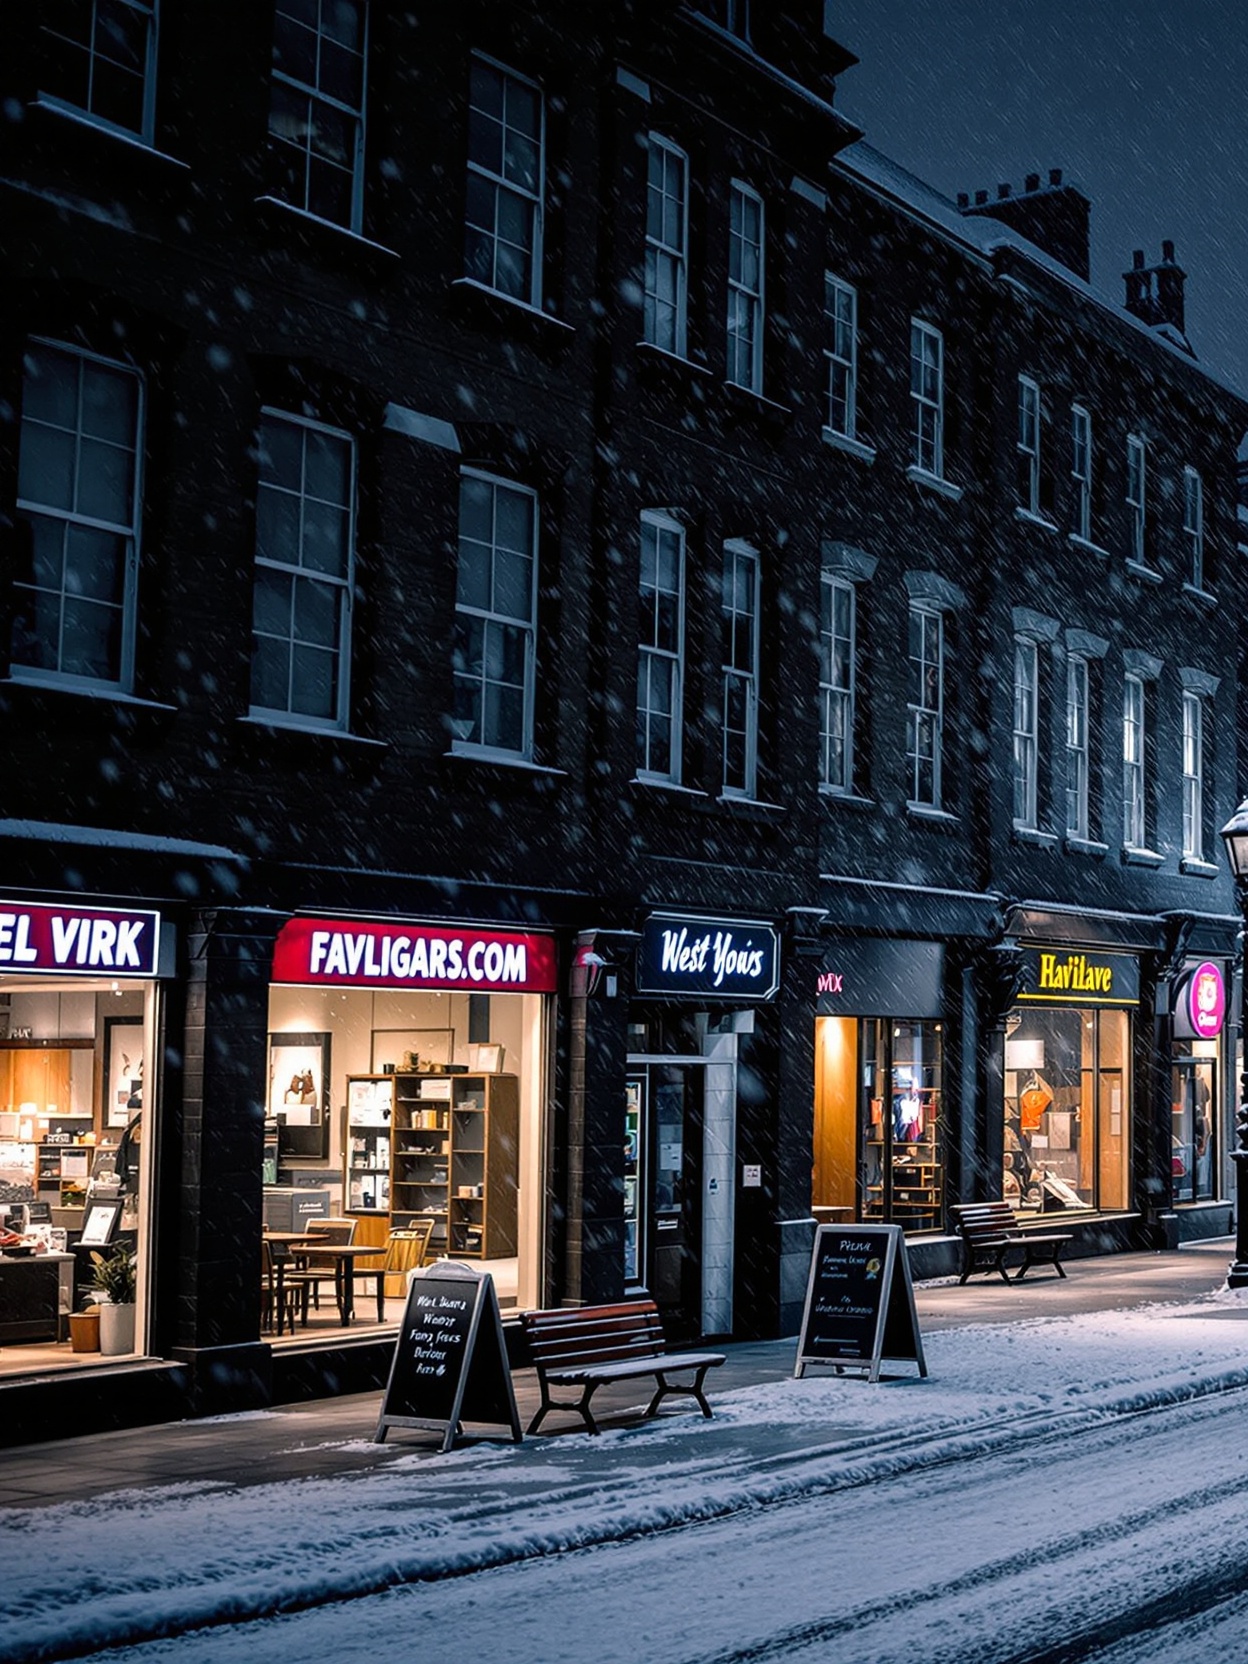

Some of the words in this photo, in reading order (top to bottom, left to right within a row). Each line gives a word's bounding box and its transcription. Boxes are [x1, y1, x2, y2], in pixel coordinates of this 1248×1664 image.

[51, 916, 145, 967] VIRK
[310, 931, 527, 983] FAVLIGARS.COM
[661, 927, 711, 973] West
